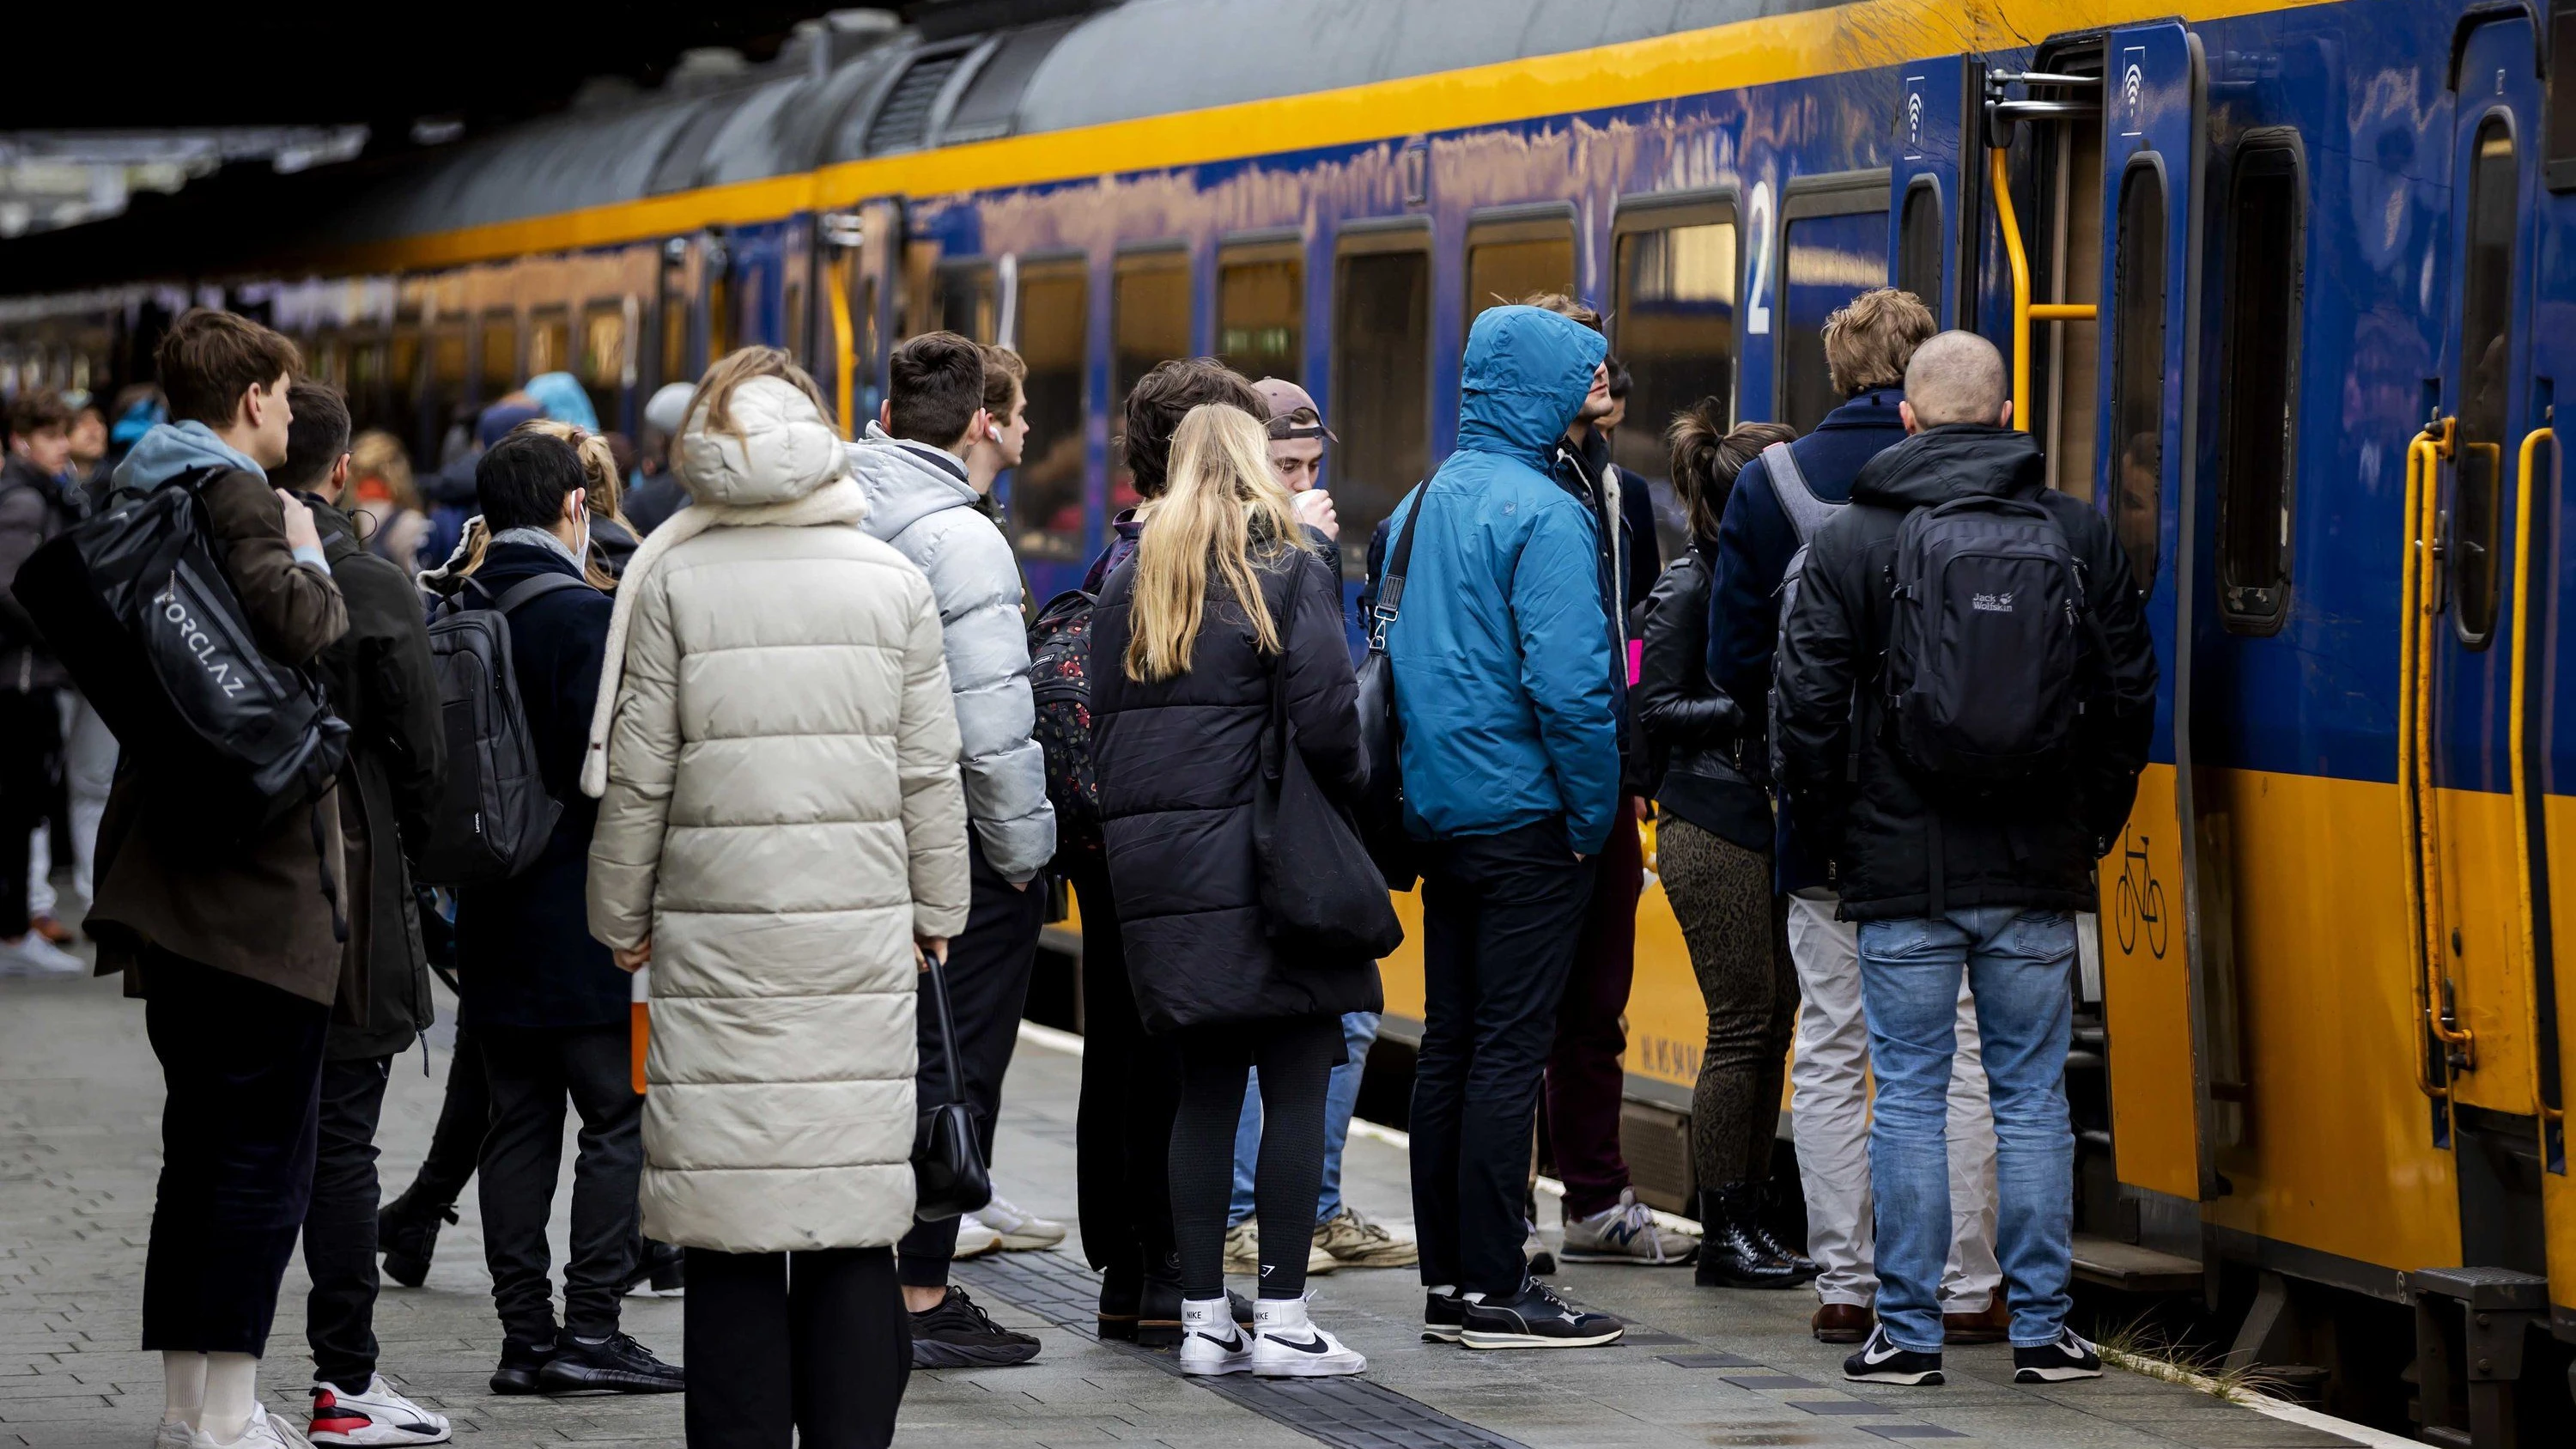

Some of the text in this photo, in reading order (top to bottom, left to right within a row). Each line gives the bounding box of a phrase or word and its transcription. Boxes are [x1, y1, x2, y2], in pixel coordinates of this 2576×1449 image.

[1747, 180, 1771, 334] 2
[1972, 593, 1996, 602] Jack
[1972, 601, 2013, 612] Wolfskin
[154, 592, 245, 698] FORCLAZ
[1187, 1311, 1202, 1319] NIKE
[1255, 1312, 1269, 1320] NIKE
